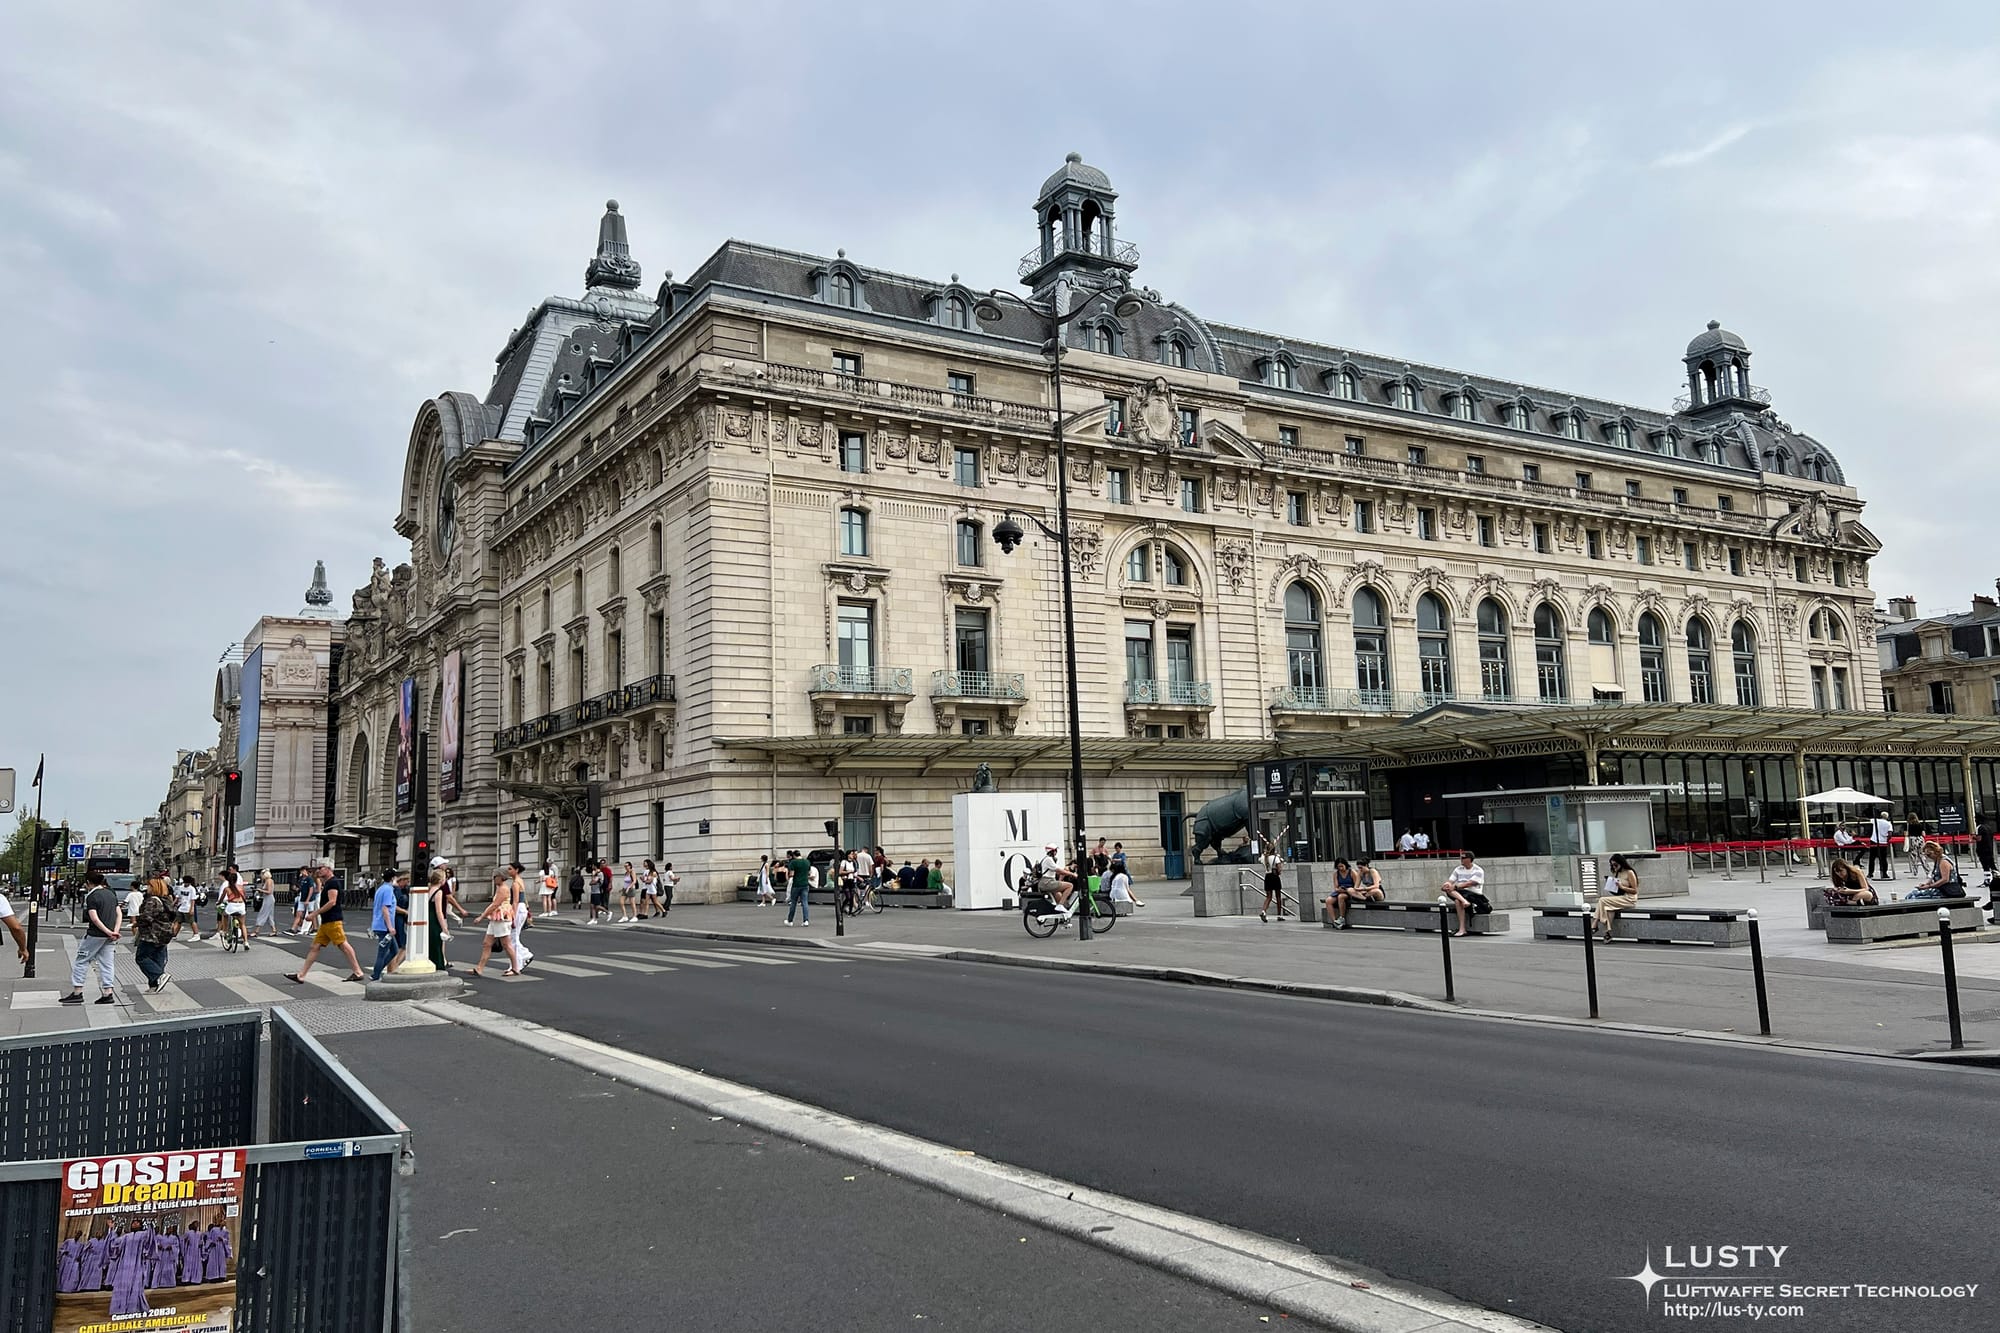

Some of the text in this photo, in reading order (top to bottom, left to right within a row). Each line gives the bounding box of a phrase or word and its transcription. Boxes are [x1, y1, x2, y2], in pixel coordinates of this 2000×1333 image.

[1002, 809, 1031, 841] M
[67, 1152, 242, 1190] GOSPEL
[103, 1179, 195, 1205] Dream
[65, 1207, 92, 1217] CHANTS
[93, 1204, 142, 1215] AUTHENTIQUES
[143, 1202, 152, 1211] DE
[79, 1320, 145, 1333] CATHÉDRALE
[145, 1313, 207, 1328] AMÉRICAINE
[111, 1313, 142, 1321] Concerts
[148, 1307, 177, 1317] 20H30
